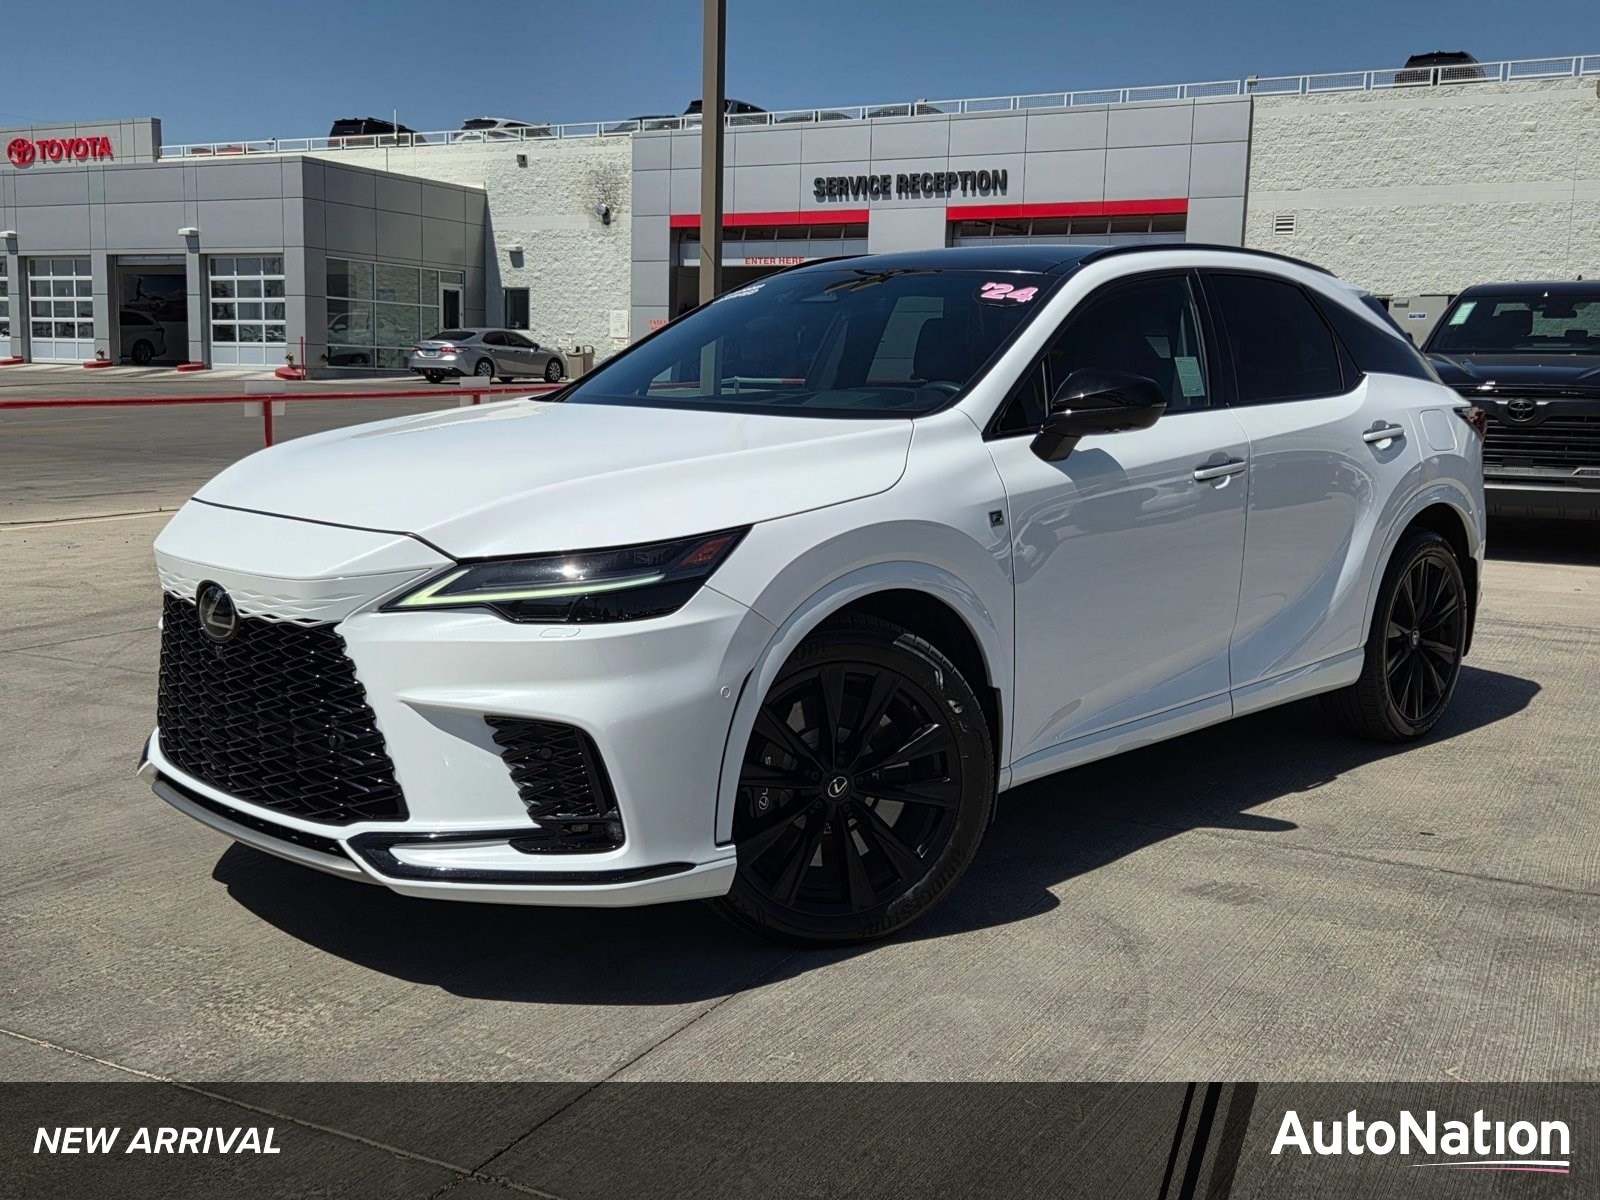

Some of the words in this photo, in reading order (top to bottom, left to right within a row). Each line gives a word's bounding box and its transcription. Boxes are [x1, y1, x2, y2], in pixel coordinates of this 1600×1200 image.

[36, 137, 112, 161] TOYOTA
[813, 174, 892, 199] SERVICE
[896, 168, 1008, 196] RECEPTION
[745, 256, 776, 265] ENTER
